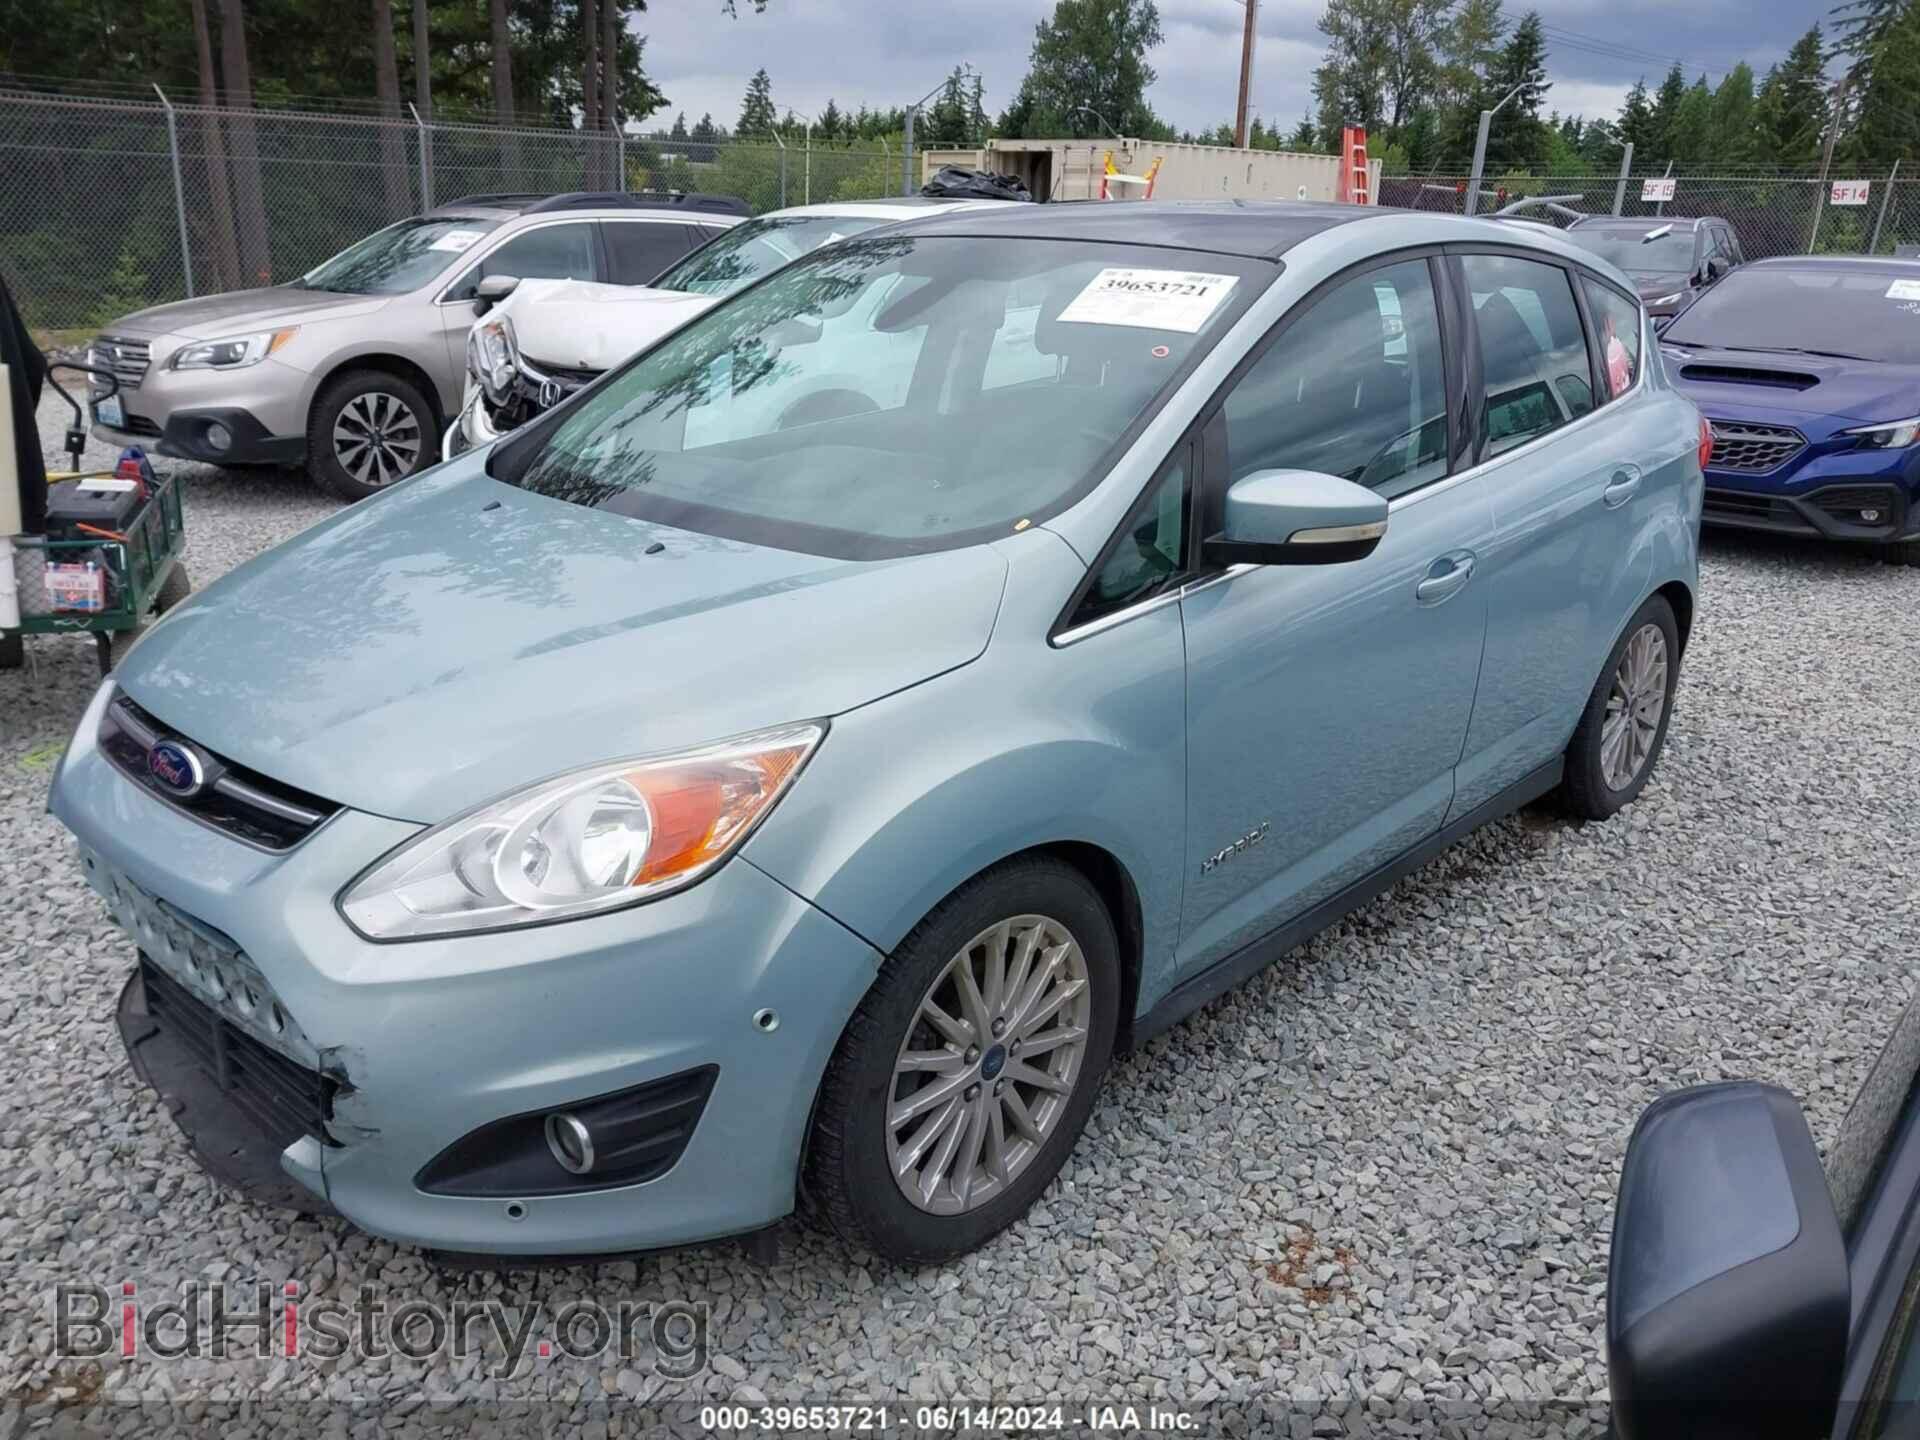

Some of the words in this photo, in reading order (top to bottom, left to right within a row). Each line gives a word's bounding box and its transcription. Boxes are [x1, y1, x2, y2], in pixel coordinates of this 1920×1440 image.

[1643, 183, 1658, 195] SF
[1833, 188, 1849, 200] SF
[1853, 188, 1866, 200] 14
[1100, 279, 1208, 297] 39653721
